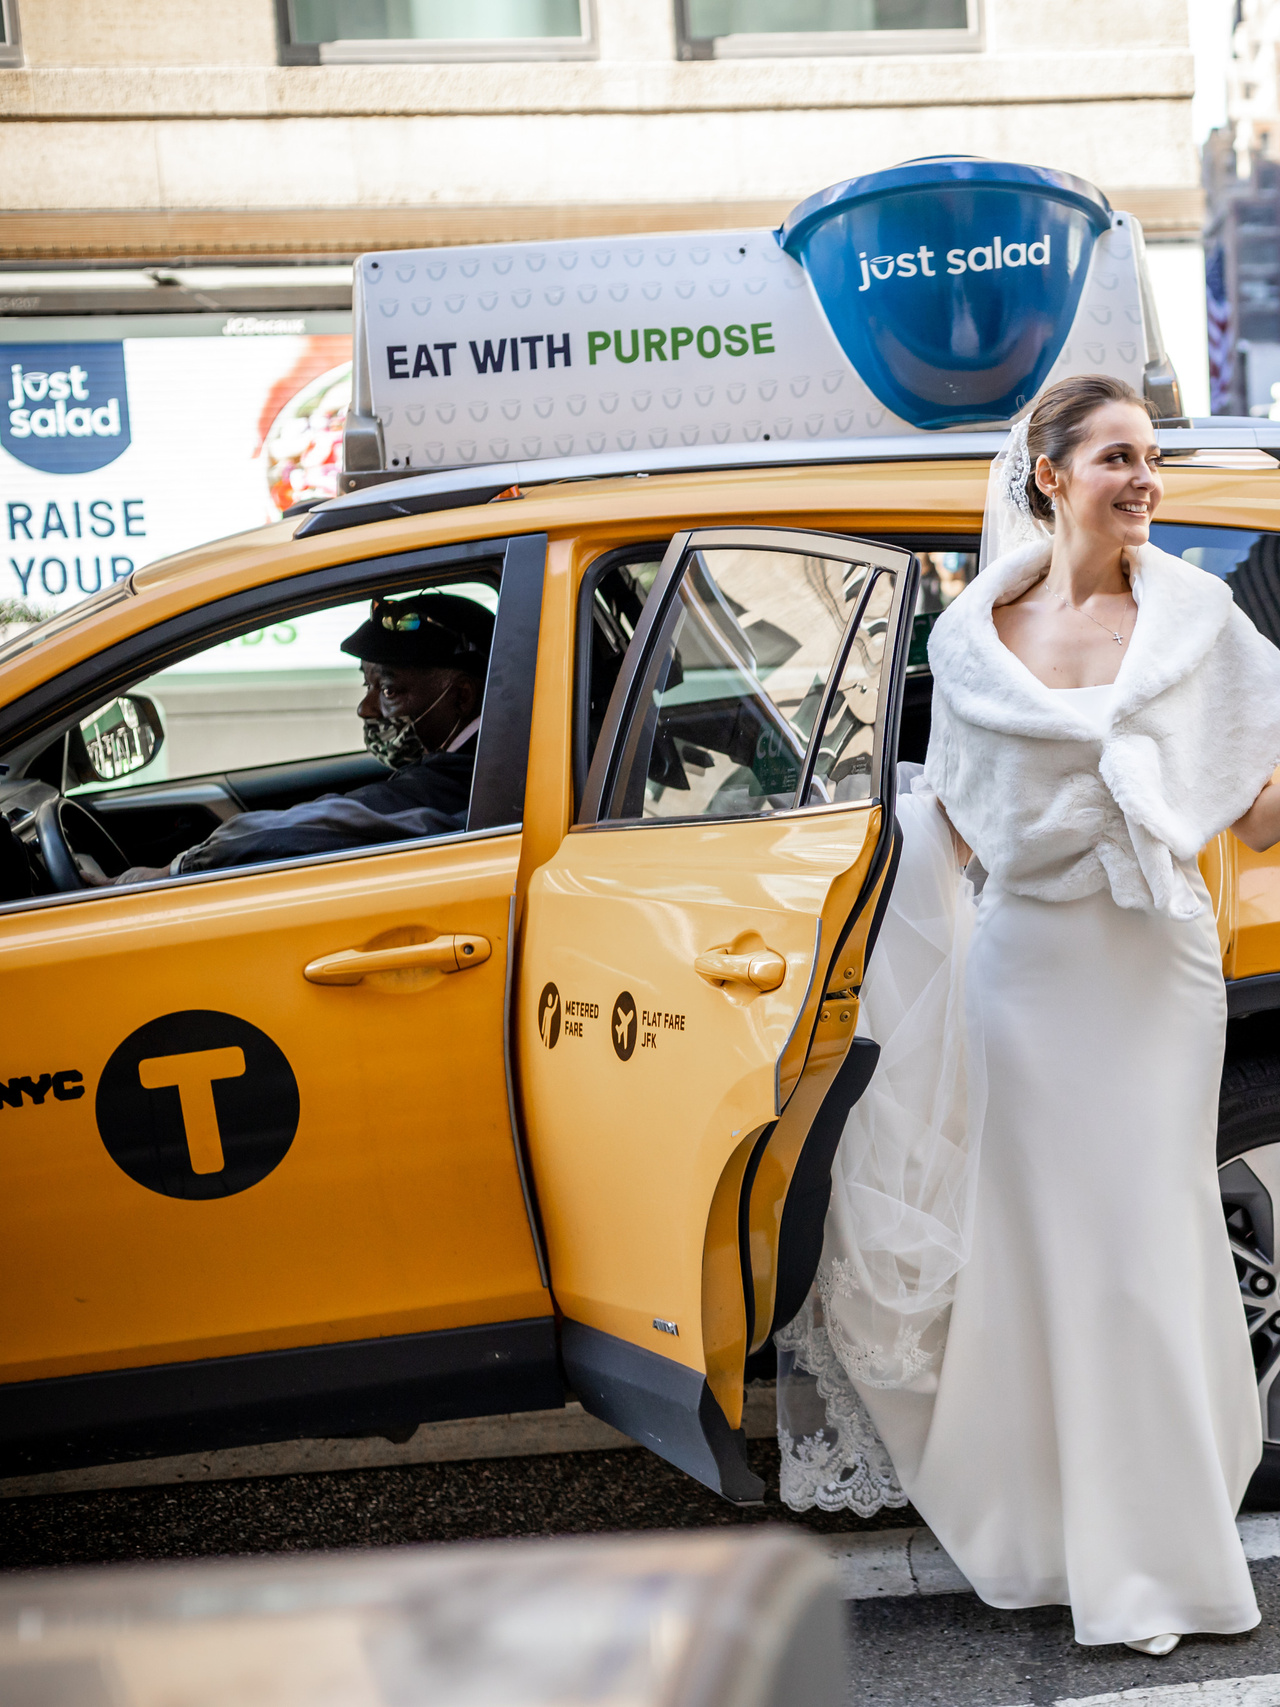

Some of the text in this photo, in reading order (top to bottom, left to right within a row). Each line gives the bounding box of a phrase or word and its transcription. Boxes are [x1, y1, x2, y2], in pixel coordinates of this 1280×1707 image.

[858, 234, 1051, 292] just salad
[386, 321, 776, 380] EAT WITH PURPOSE
[8, 363, 90, 410] just
[9, 397, 122, 439] salad
[7, 499, 147, 540] RAISE
[564, 1021, 584, 1038] FARE
[565, 1000, 600, 1020] METERED
[642, 1010, 686, 1031] FLAT FARE
[641, 1032, 657, 1049] JFK
[0, 1045, 247, 1175] NYC T
